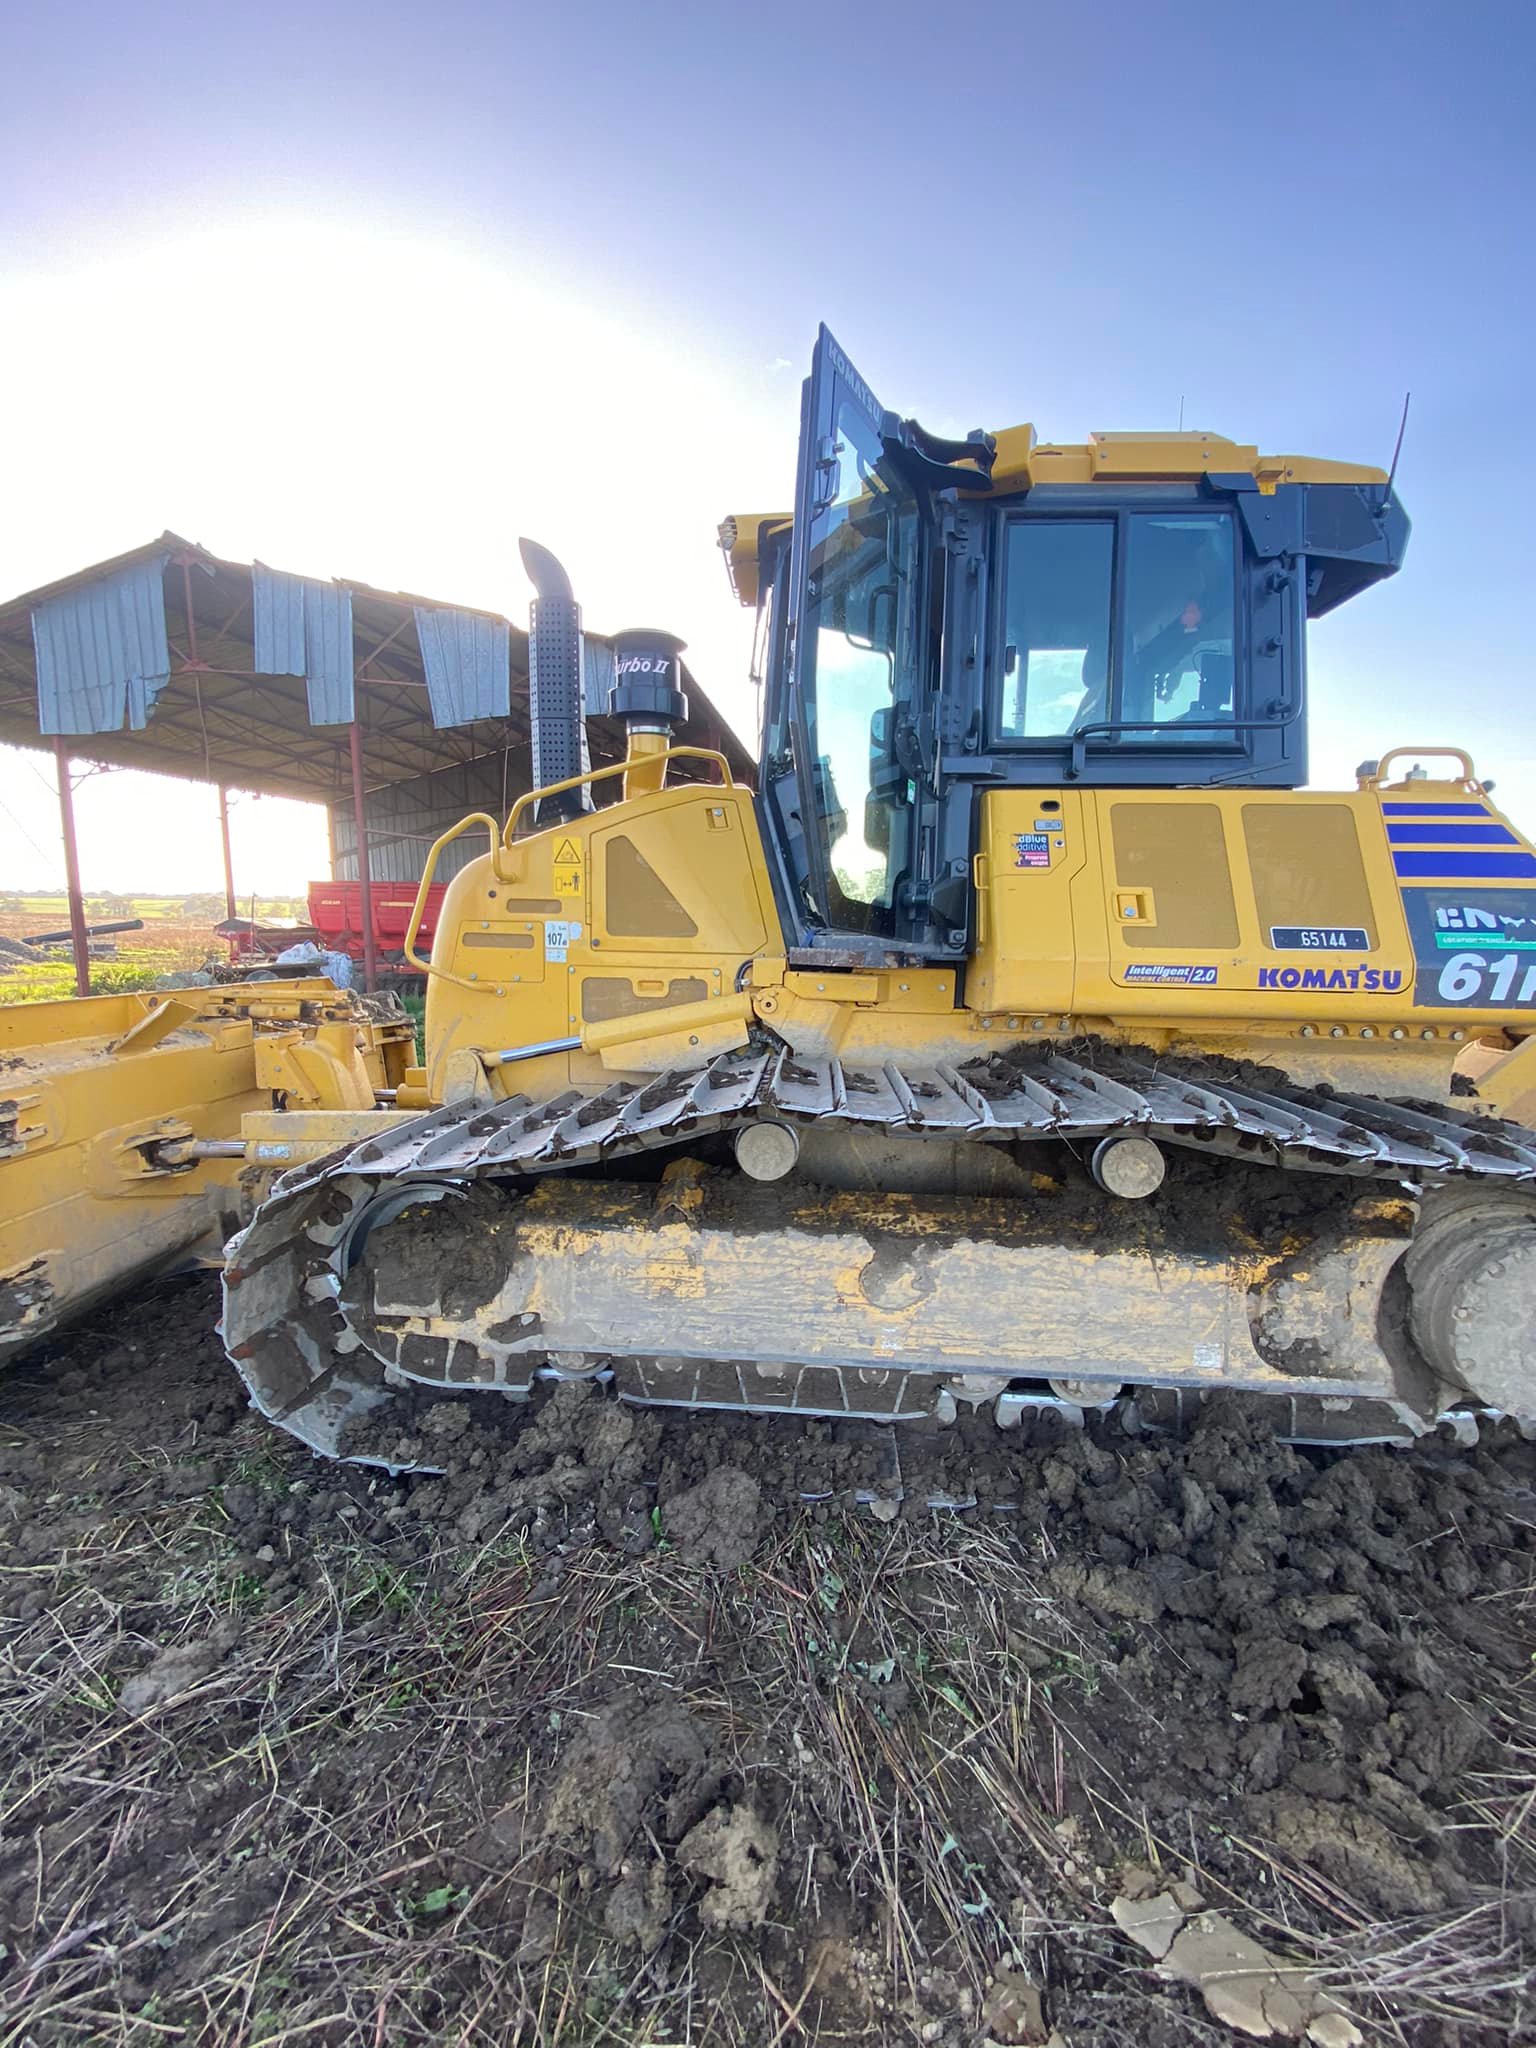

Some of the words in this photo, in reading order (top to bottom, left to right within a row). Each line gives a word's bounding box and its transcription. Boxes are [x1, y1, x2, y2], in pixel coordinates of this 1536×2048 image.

[828, 341, 880, 424] KOMATSU
[547, 932, 562, 946] 107
[1301, 931, 1347, 947] 65144
[1192, 968, 1216, 982] 2.0
[1258, 963, 1401, 990] KOMATSU
